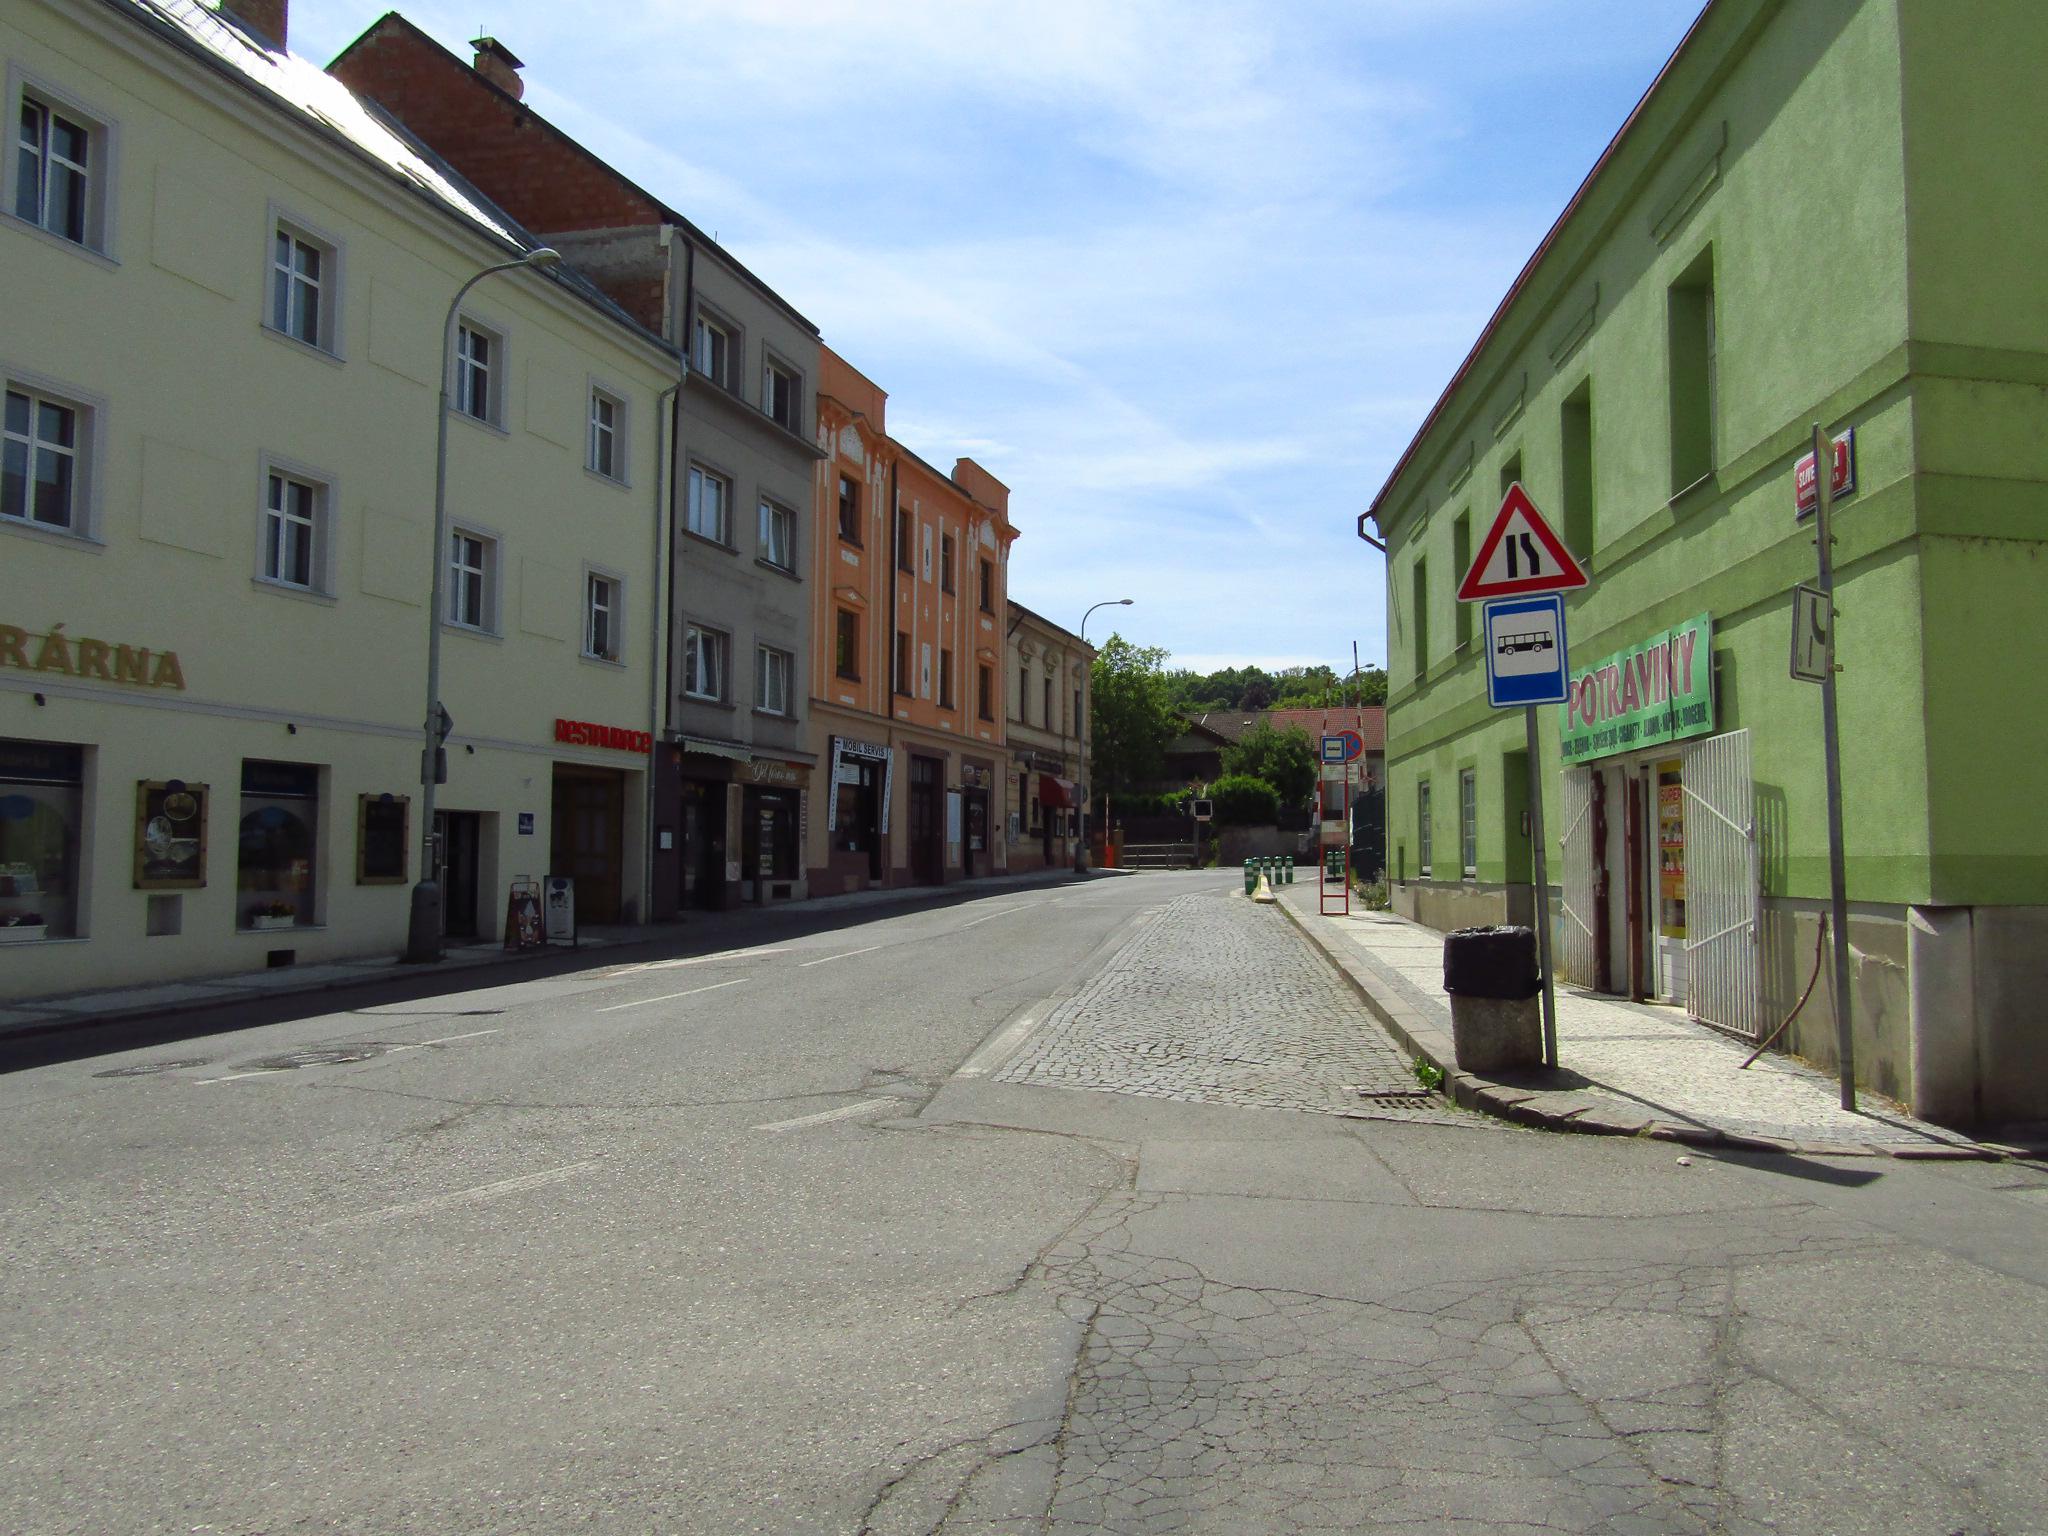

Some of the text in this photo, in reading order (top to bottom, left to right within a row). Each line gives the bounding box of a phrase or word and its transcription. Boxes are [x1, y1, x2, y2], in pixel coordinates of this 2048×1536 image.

[0, 622, 187, 690] RÁRNA
[1567, 628, 1698, 732] POTRAVINY
[843, 739, 862, 752] MOBIL
[864, 743, 885, 757] SERVIS
